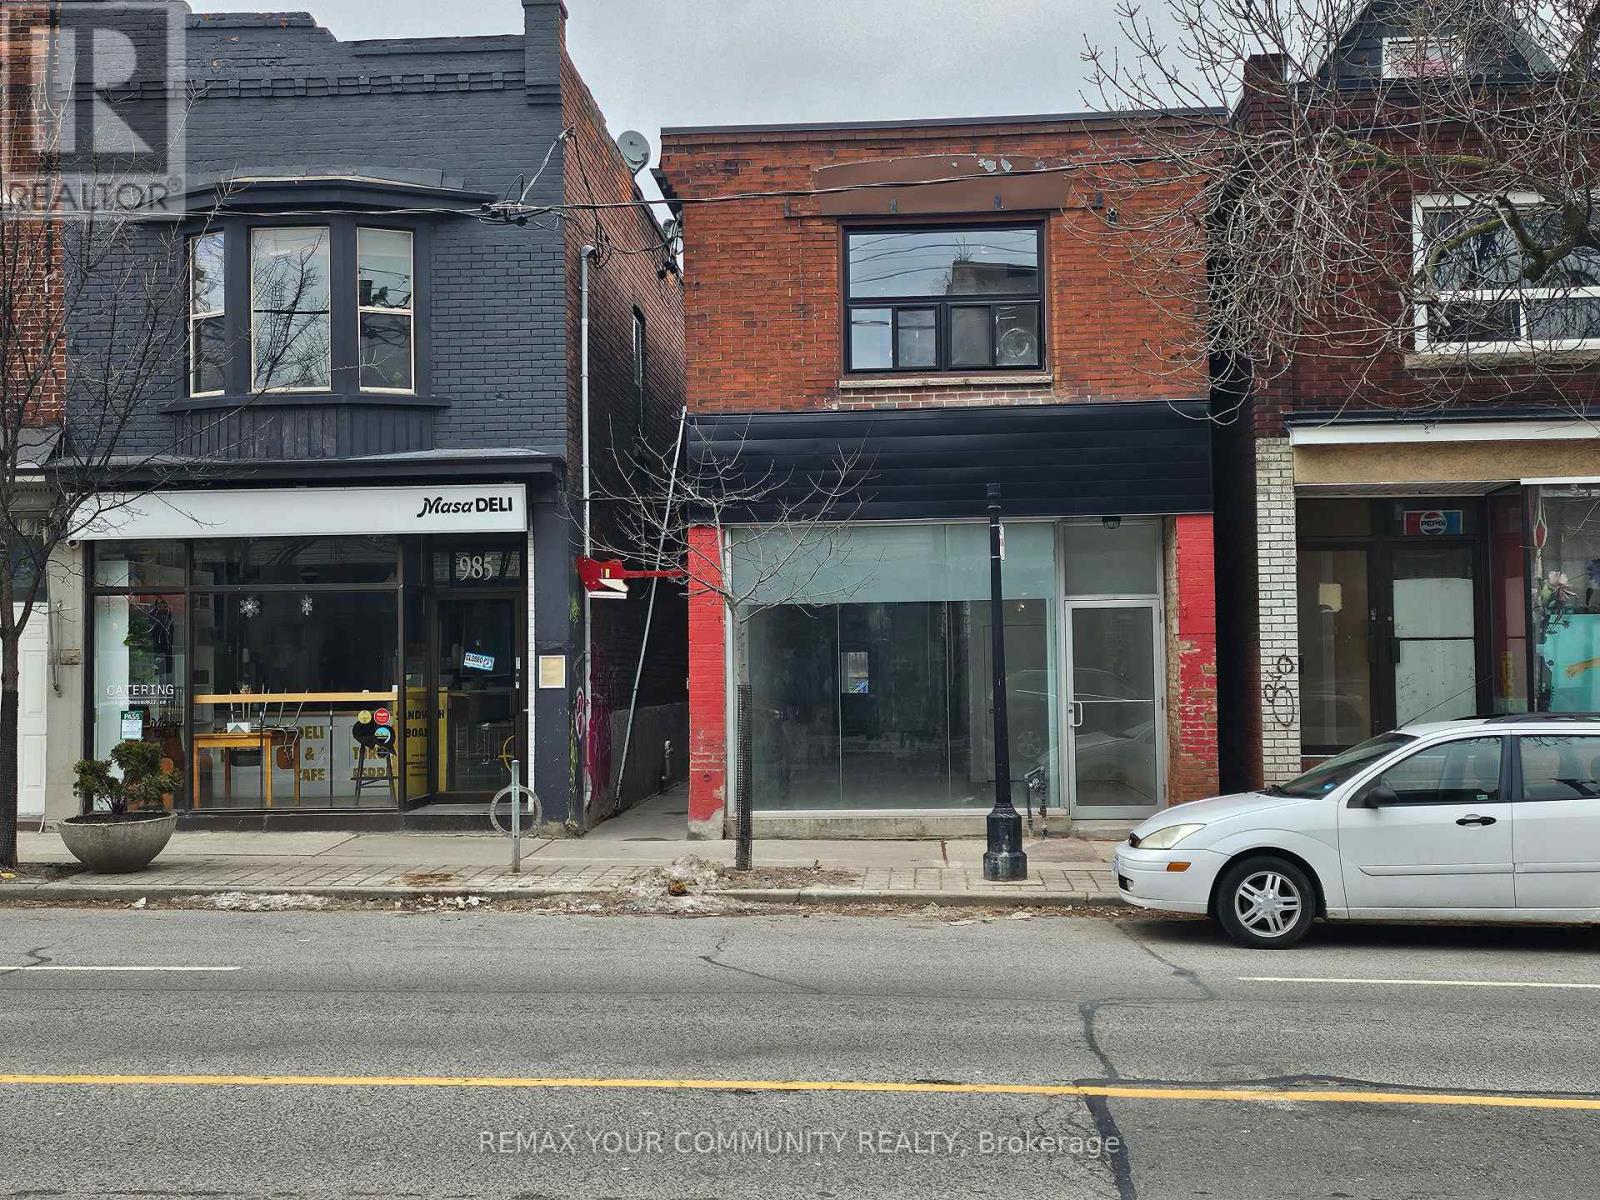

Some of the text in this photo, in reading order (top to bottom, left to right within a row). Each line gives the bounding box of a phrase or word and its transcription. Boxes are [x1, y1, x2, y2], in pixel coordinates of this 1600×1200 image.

[416, 496, 513, 518] Masa DELI
[459, 555, 493, 581] 985
[106, 684, 174, 696] CATERING
[124, 713, 140, 721] PASS
[304, 746, 315, 761] &
